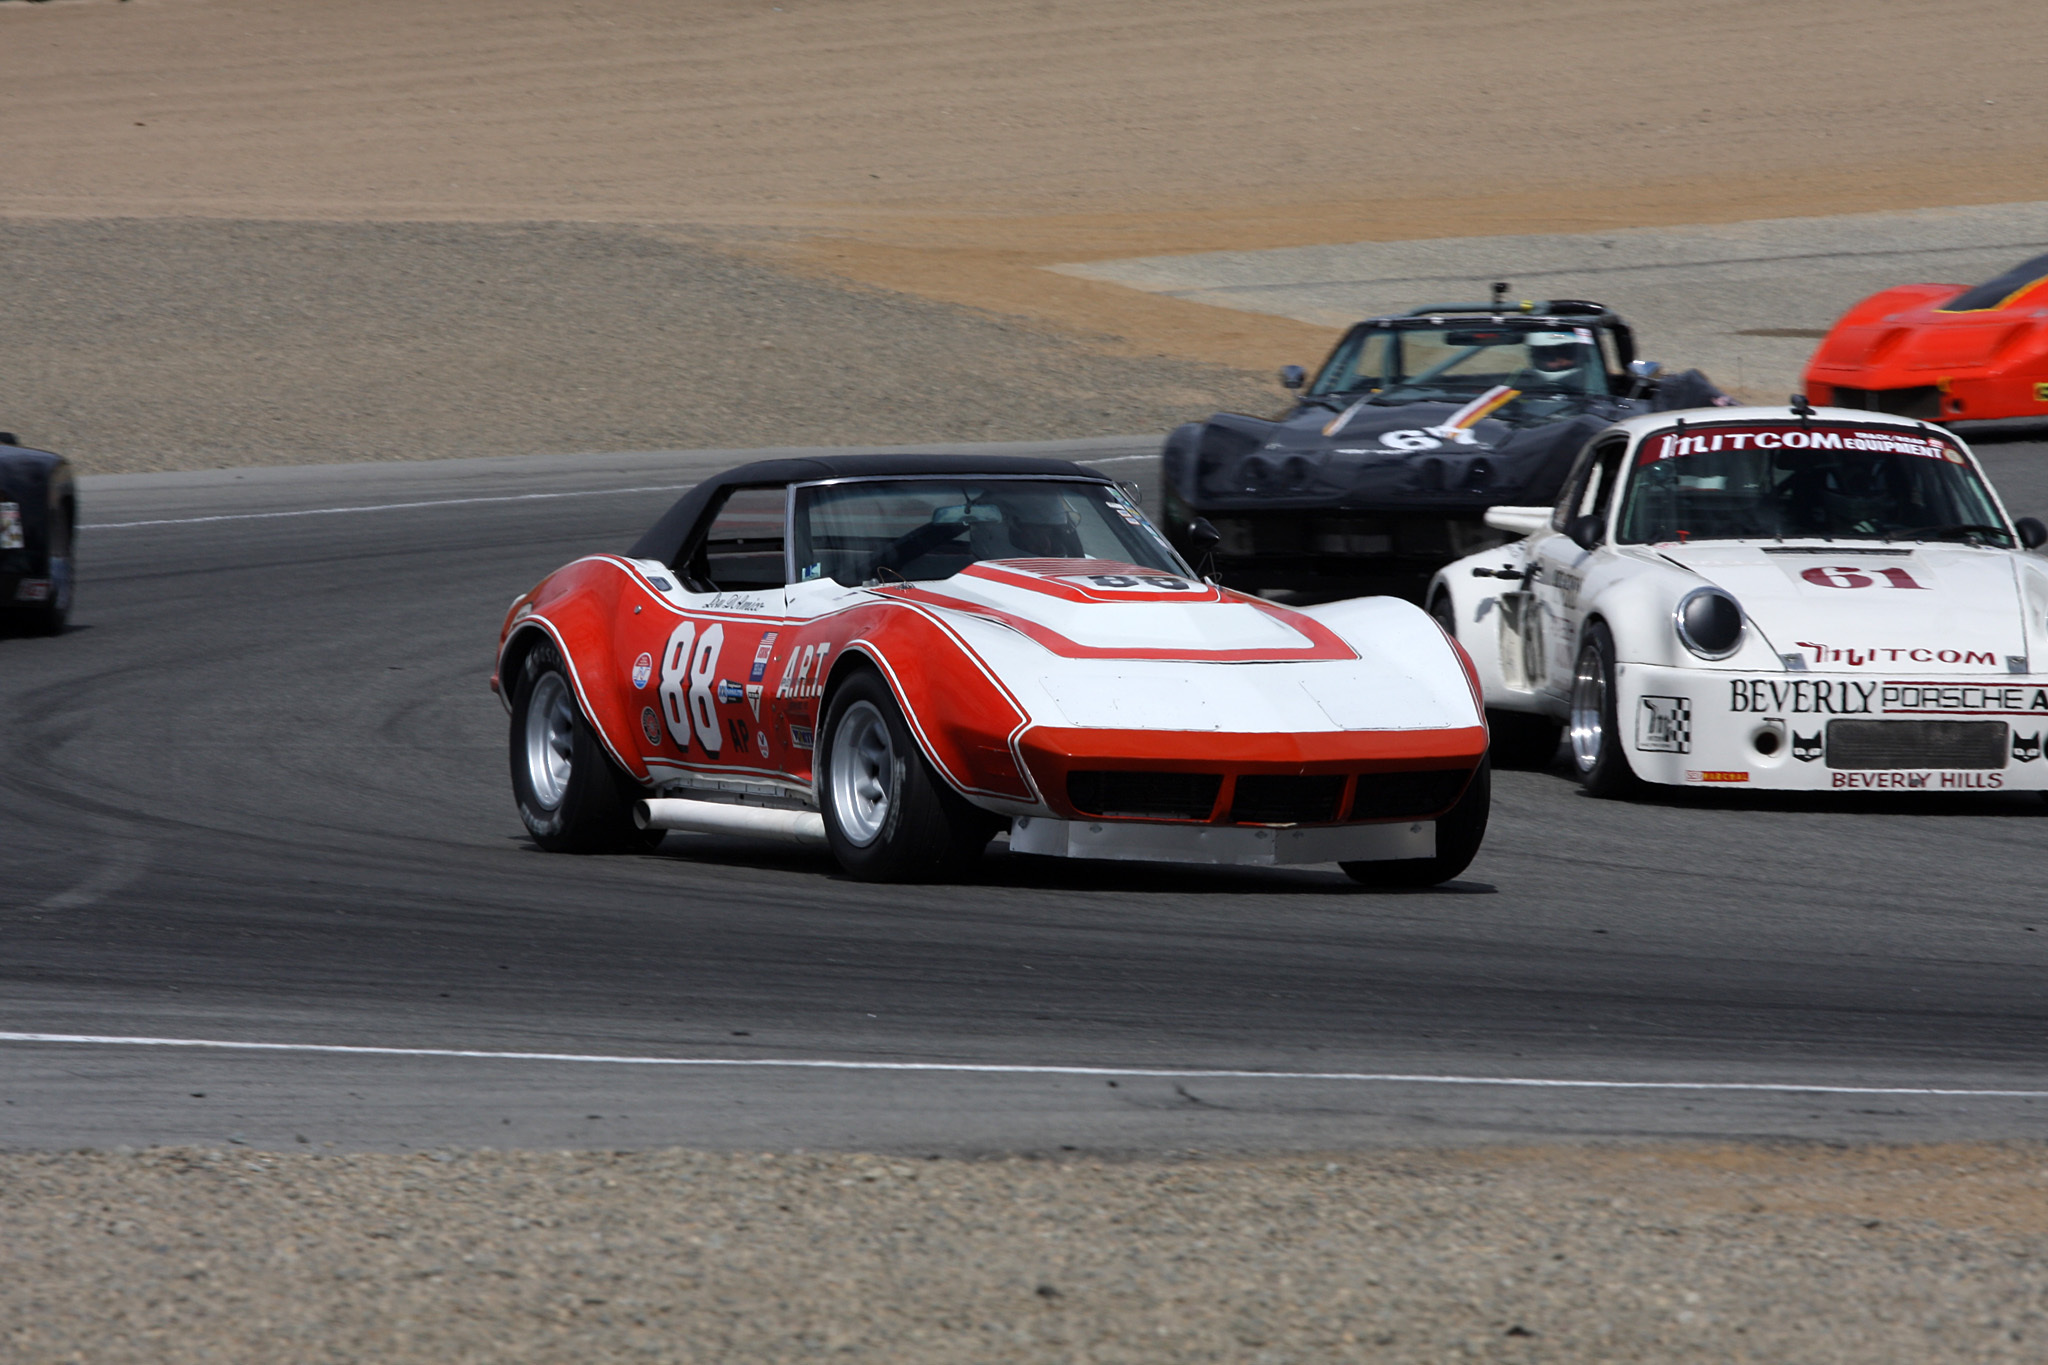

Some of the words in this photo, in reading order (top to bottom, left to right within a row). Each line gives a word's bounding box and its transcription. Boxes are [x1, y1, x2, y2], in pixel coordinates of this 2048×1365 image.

[1843, 438, 1942, 458] EQUIPMENT
[1088, 575, 1190, 590] 88
[1801, 566, 1934, 590] 61
[1795, 641, 1997, 666] MITCOM
[660, 620, 724, 758] 88
[1729, 680, 1877, 714] BEVERLY
[1881, 687, 2024, 709] PORSCHE
[728, 718, 750, 753] AP
[1831, 772, 1929, 789] BEVERLY
[1940, 772, 2004, 789] HILLS
